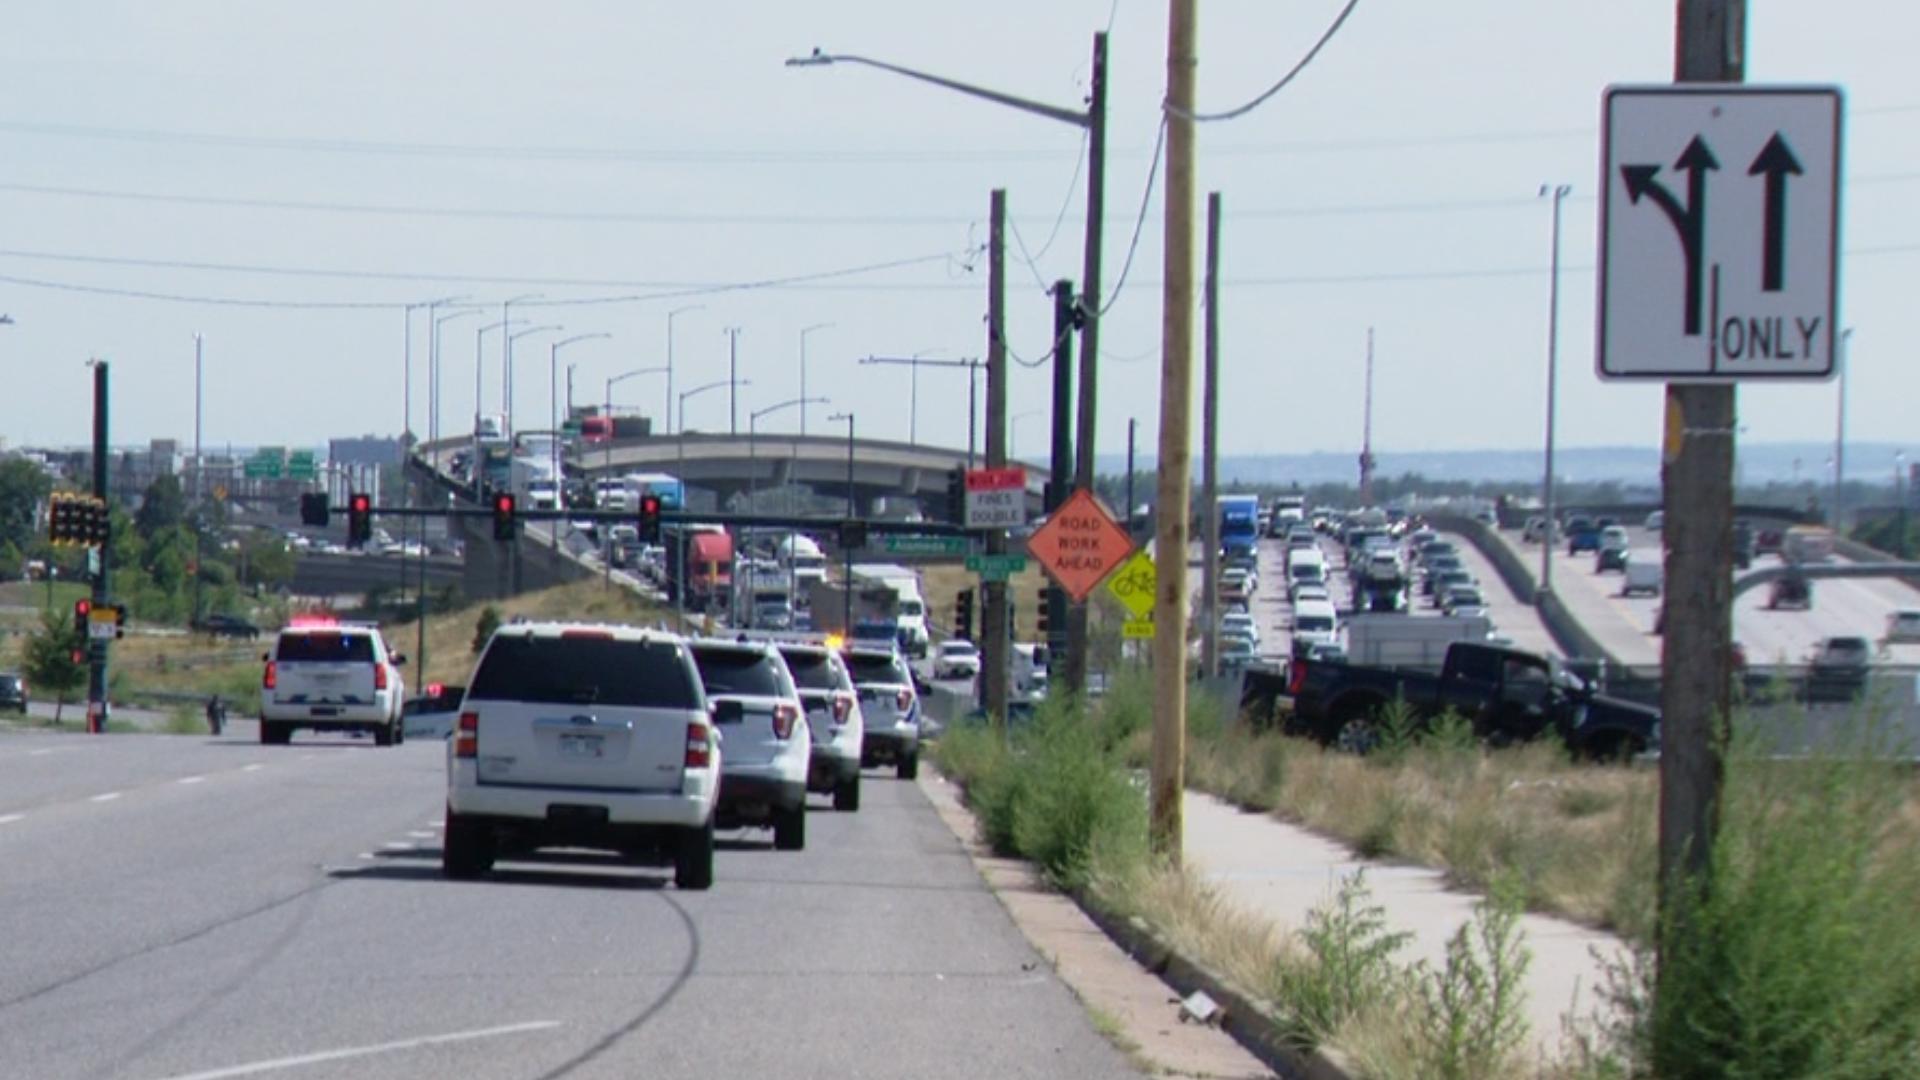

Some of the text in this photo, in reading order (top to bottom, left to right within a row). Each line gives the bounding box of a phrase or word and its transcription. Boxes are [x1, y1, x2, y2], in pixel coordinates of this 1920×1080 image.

[1722, 316, 1821, 360] ONLY
[976, 493, 1012, 506] FINES
[971, 509, 1018, 523] DOUBLE
[1059, 517, 1100, 530] ROAD
[1058, 537, 1100, 550] WORK
[1055, 556, 1103, 570] AHEAD
